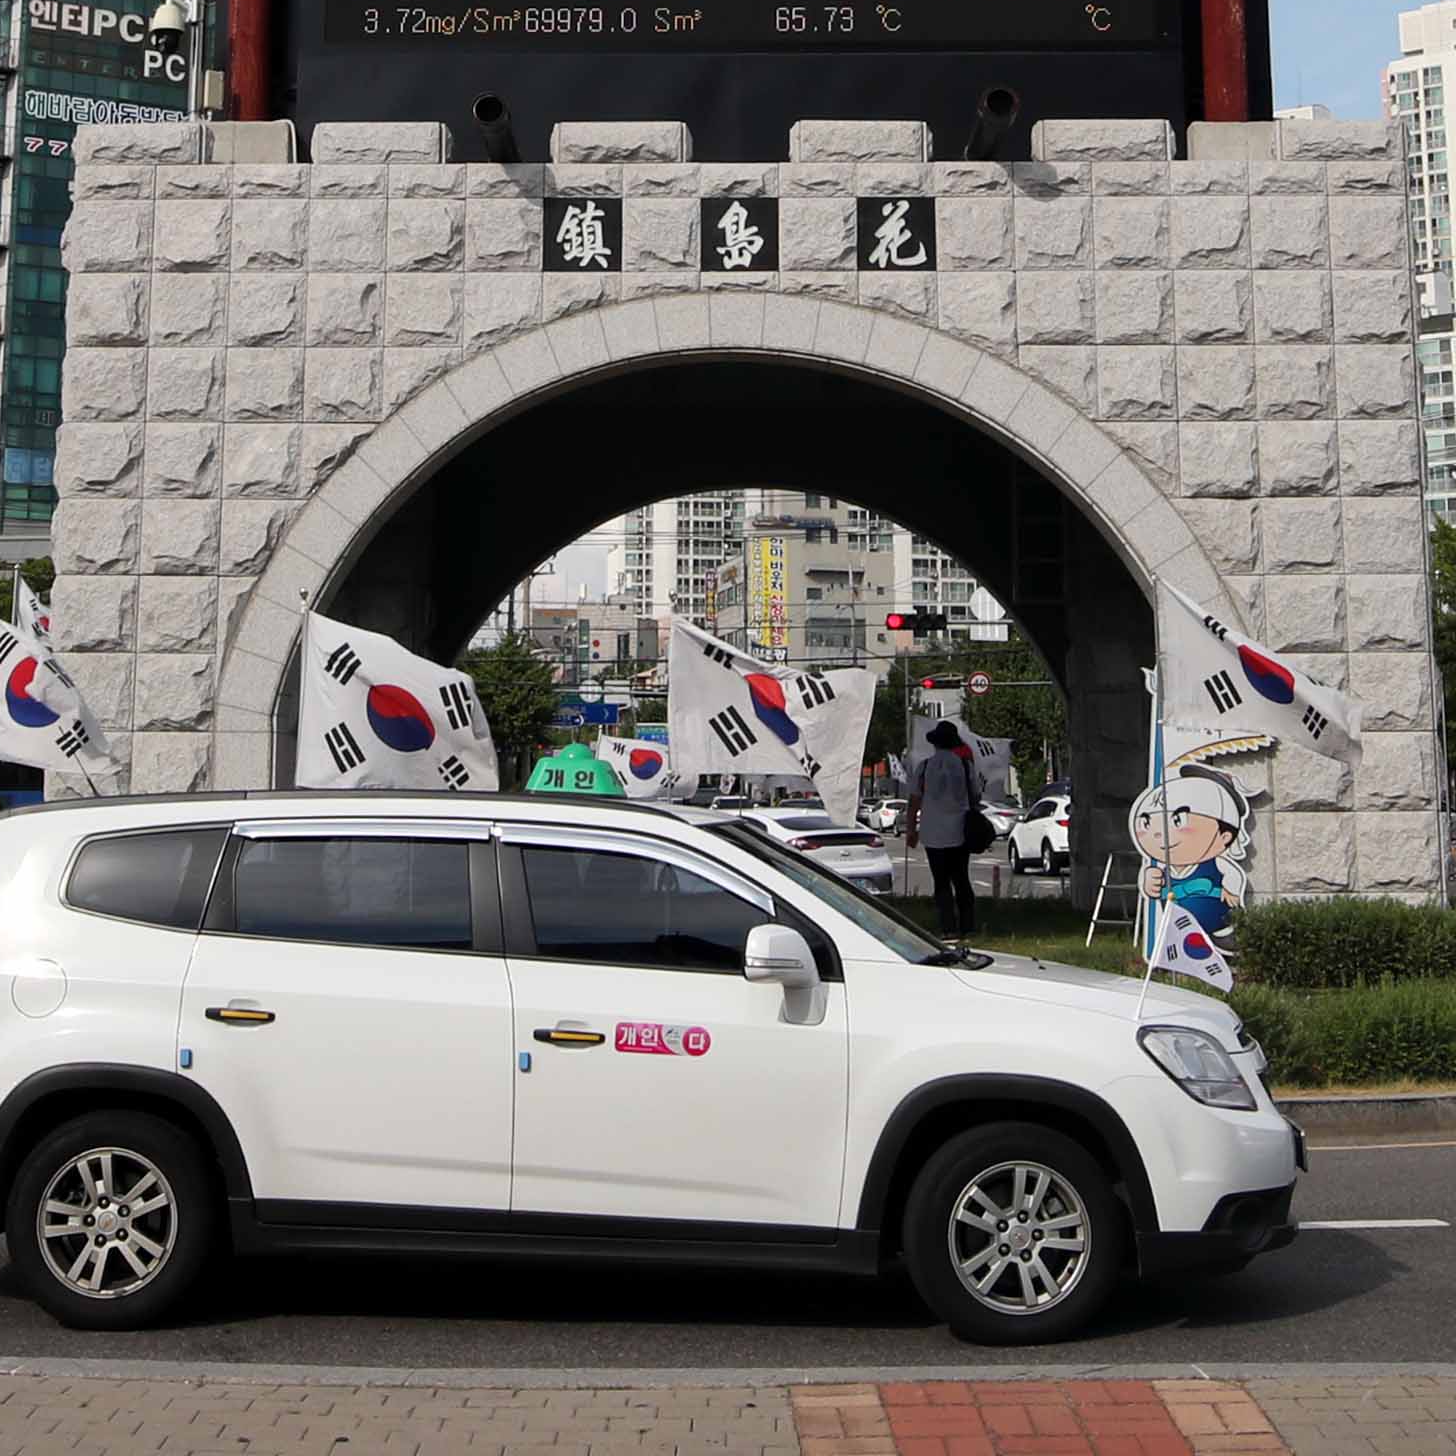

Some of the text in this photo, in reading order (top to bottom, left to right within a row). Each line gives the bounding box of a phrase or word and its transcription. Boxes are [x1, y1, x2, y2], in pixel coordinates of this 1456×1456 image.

[775, 6, 855, 32] 65.73
[544, 769, 594, 789] 개인
[618, 1026, 658, 1047] 개인
